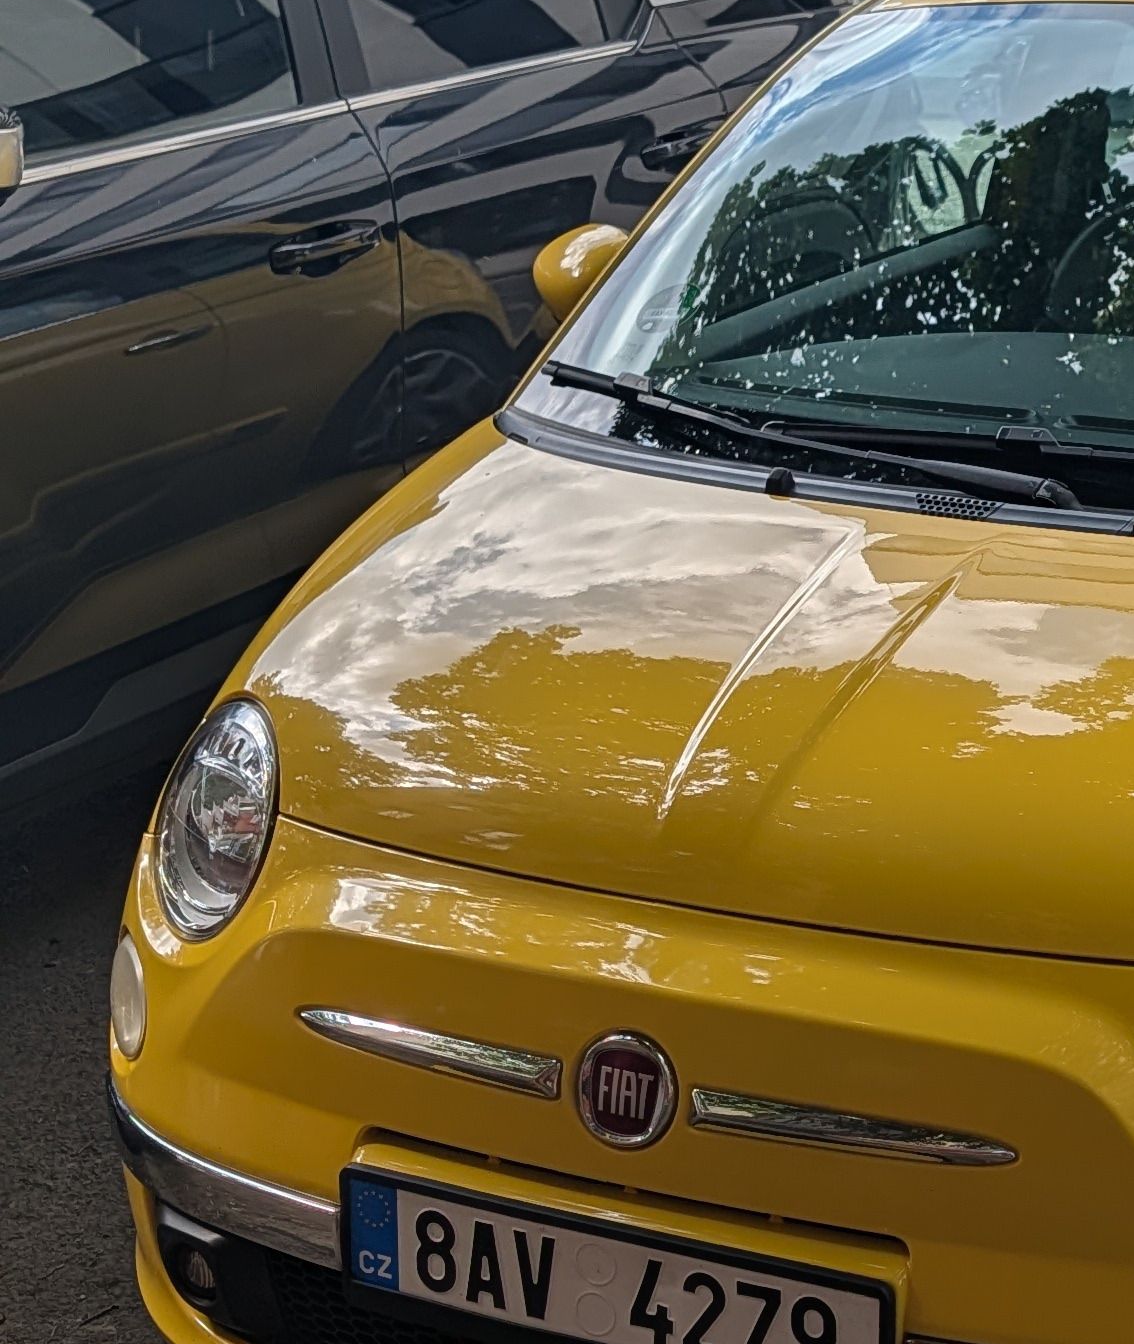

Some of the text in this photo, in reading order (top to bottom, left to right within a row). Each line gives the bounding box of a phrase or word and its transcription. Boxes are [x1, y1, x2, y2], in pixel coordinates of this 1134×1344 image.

[598, 1065, 655, 1120] FIAT
[359, 1250, 393, 1280] CZ
[415, 1210, 556, 1321] 8AV
